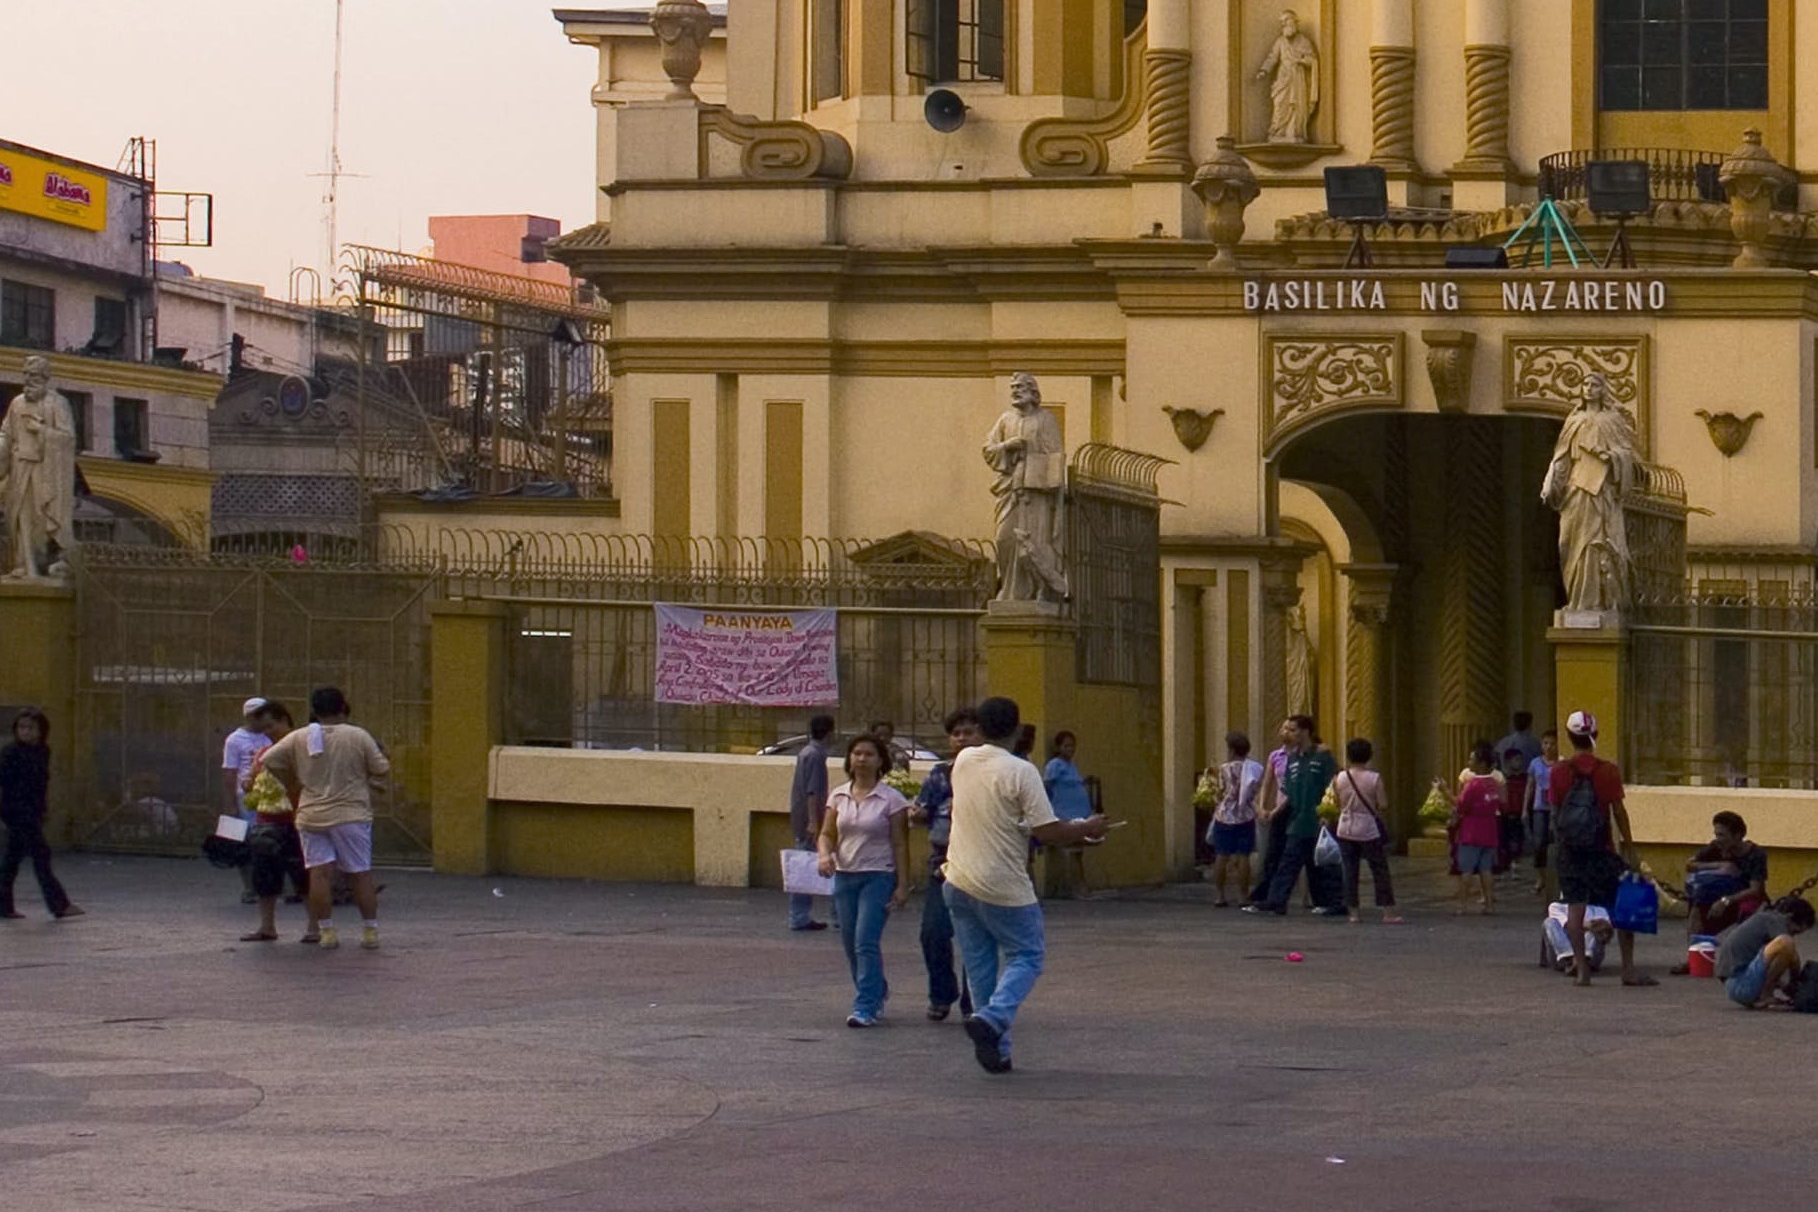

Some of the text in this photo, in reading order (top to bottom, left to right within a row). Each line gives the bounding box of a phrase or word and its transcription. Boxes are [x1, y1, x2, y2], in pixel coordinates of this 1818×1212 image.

[1243, 280, 1665, 311] BASILIKA NG NAZARENO
[703, 614, 793, 629] PAANYAYA
